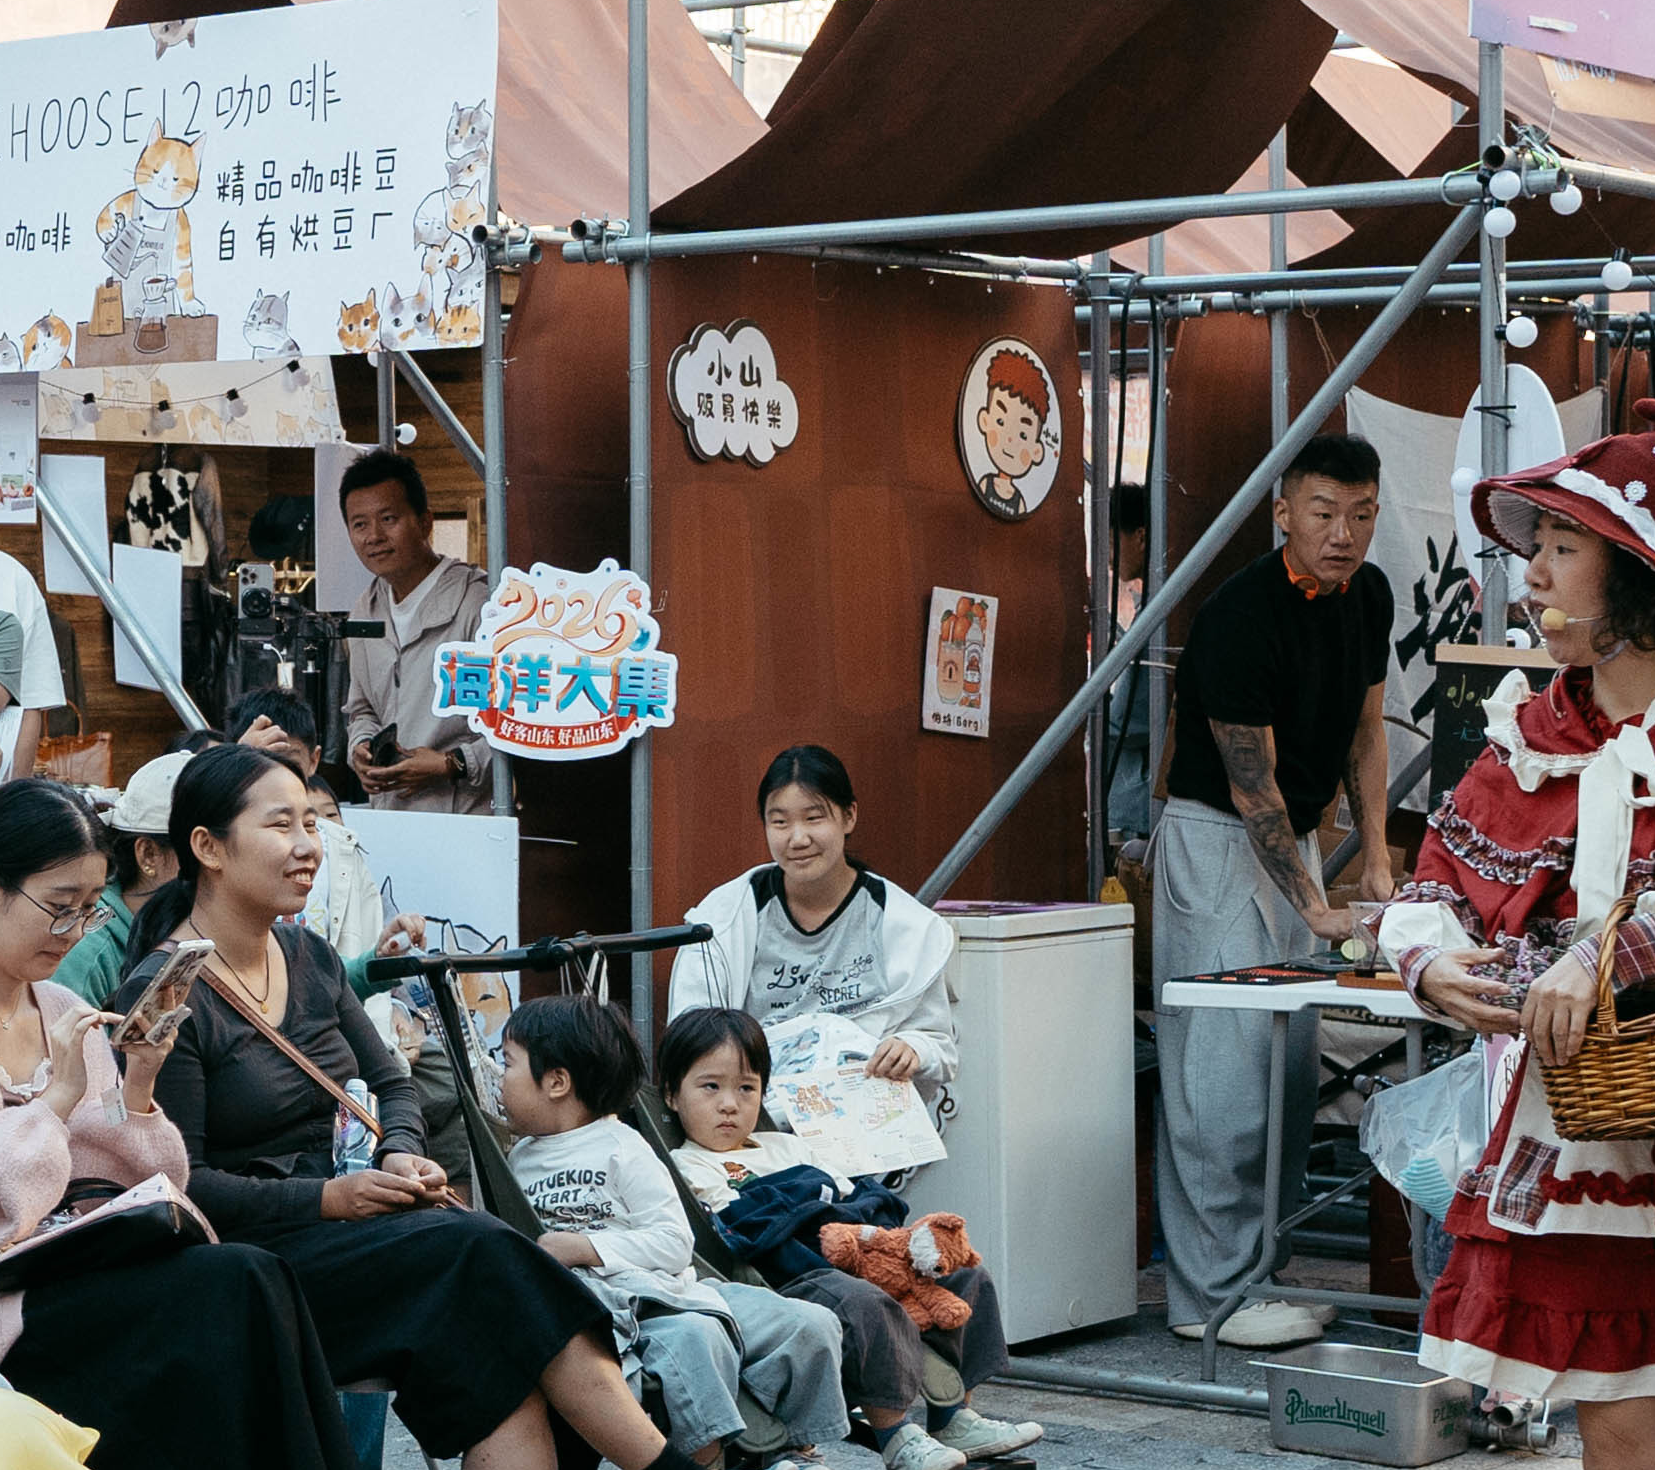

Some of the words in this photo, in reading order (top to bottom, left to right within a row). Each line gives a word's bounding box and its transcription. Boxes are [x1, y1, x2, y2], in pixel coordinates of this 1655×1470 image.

[216, 148, 397, 206] 精品咖啡豆
[219, 208, 393, 261] 自有烘豆厂
[707, 348, 762, 387] 小山
[492, 578, 639, 657] 2026
[439, 650, 671, 719] 海洋大集
[499, 719, 555, 745] 好客山东
[558, 722, 615, 746] 好品山东
[819, 982, 862, 1007] SECRET
[523, 1169, 608, 1197] UYUEKIDS
